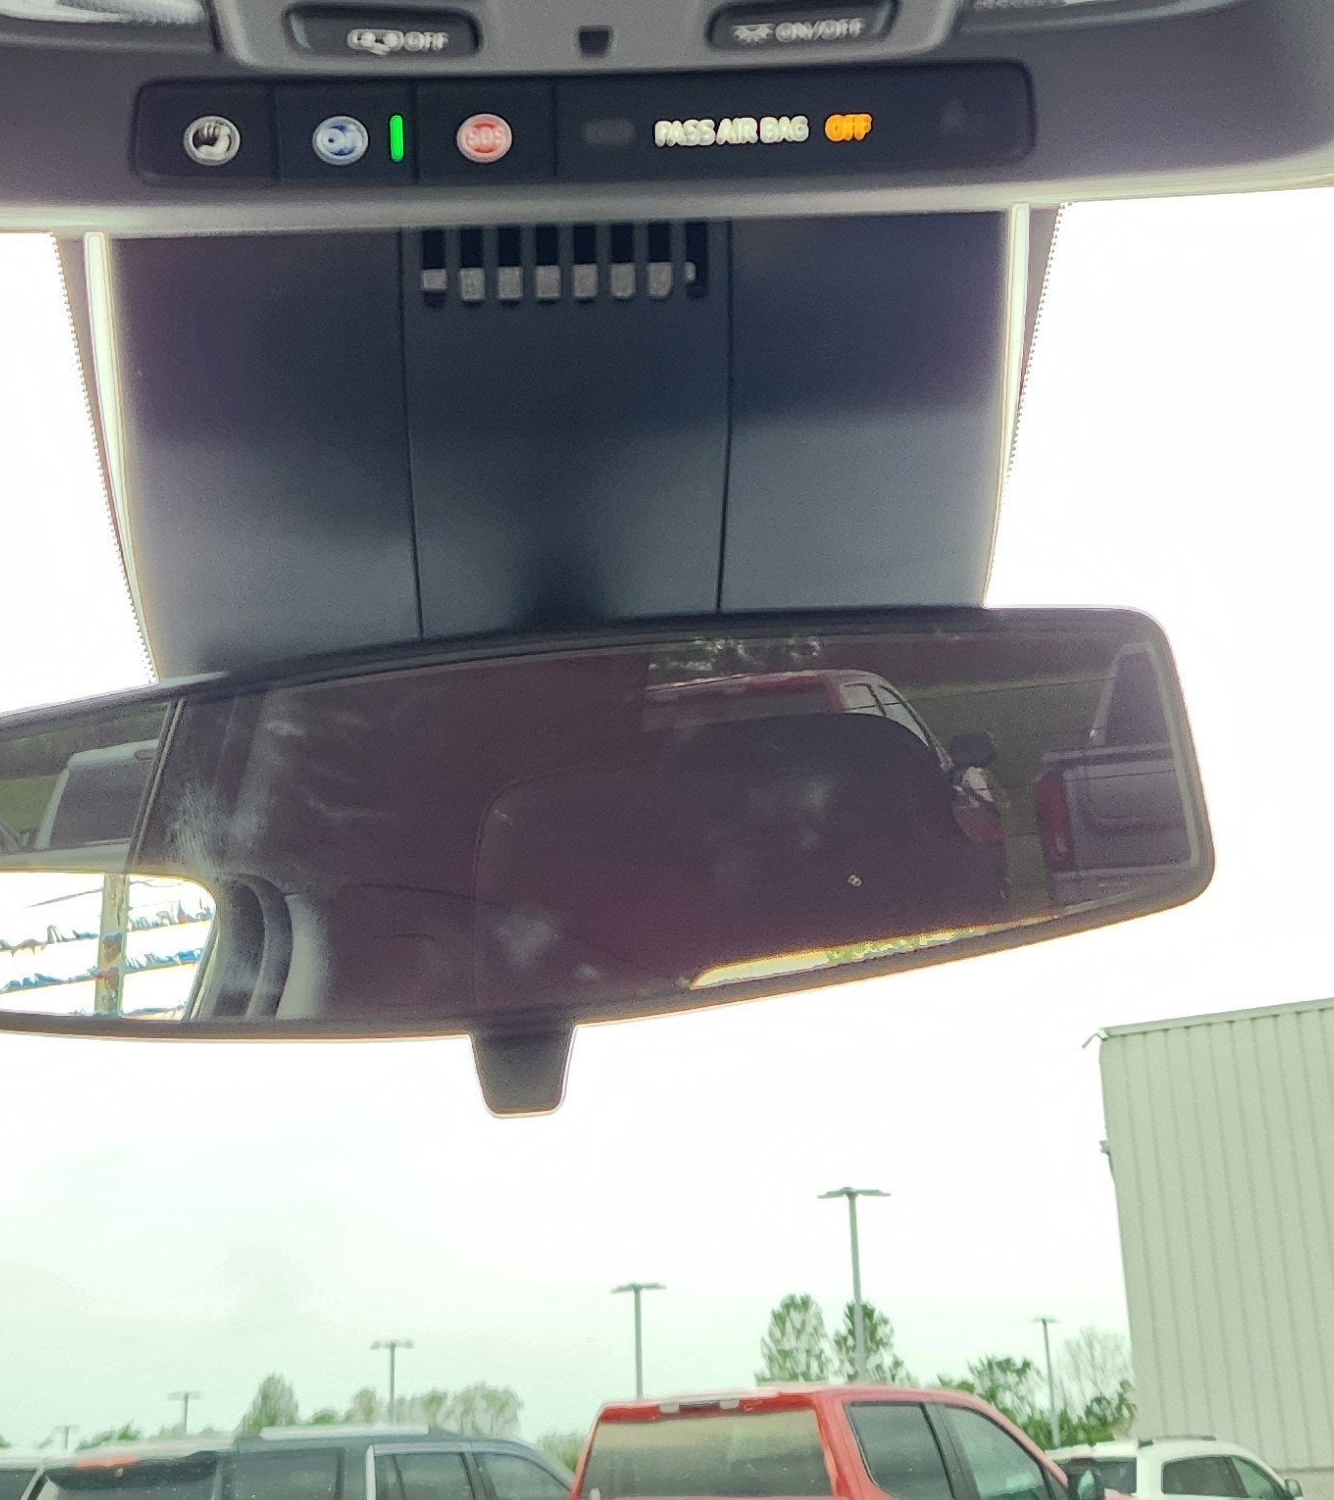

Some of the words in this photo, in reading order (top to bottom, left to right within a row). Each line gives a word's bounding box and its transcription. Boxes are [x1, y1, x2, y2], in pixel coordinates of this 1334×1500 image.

[466, 126, 505, 148] SOS
[654, 119, 715, 147] PASS
[717, 117, 758, 145] AIR
[760, 115, 809, 143] BAG
[825, 113, 872, 142] OFF
